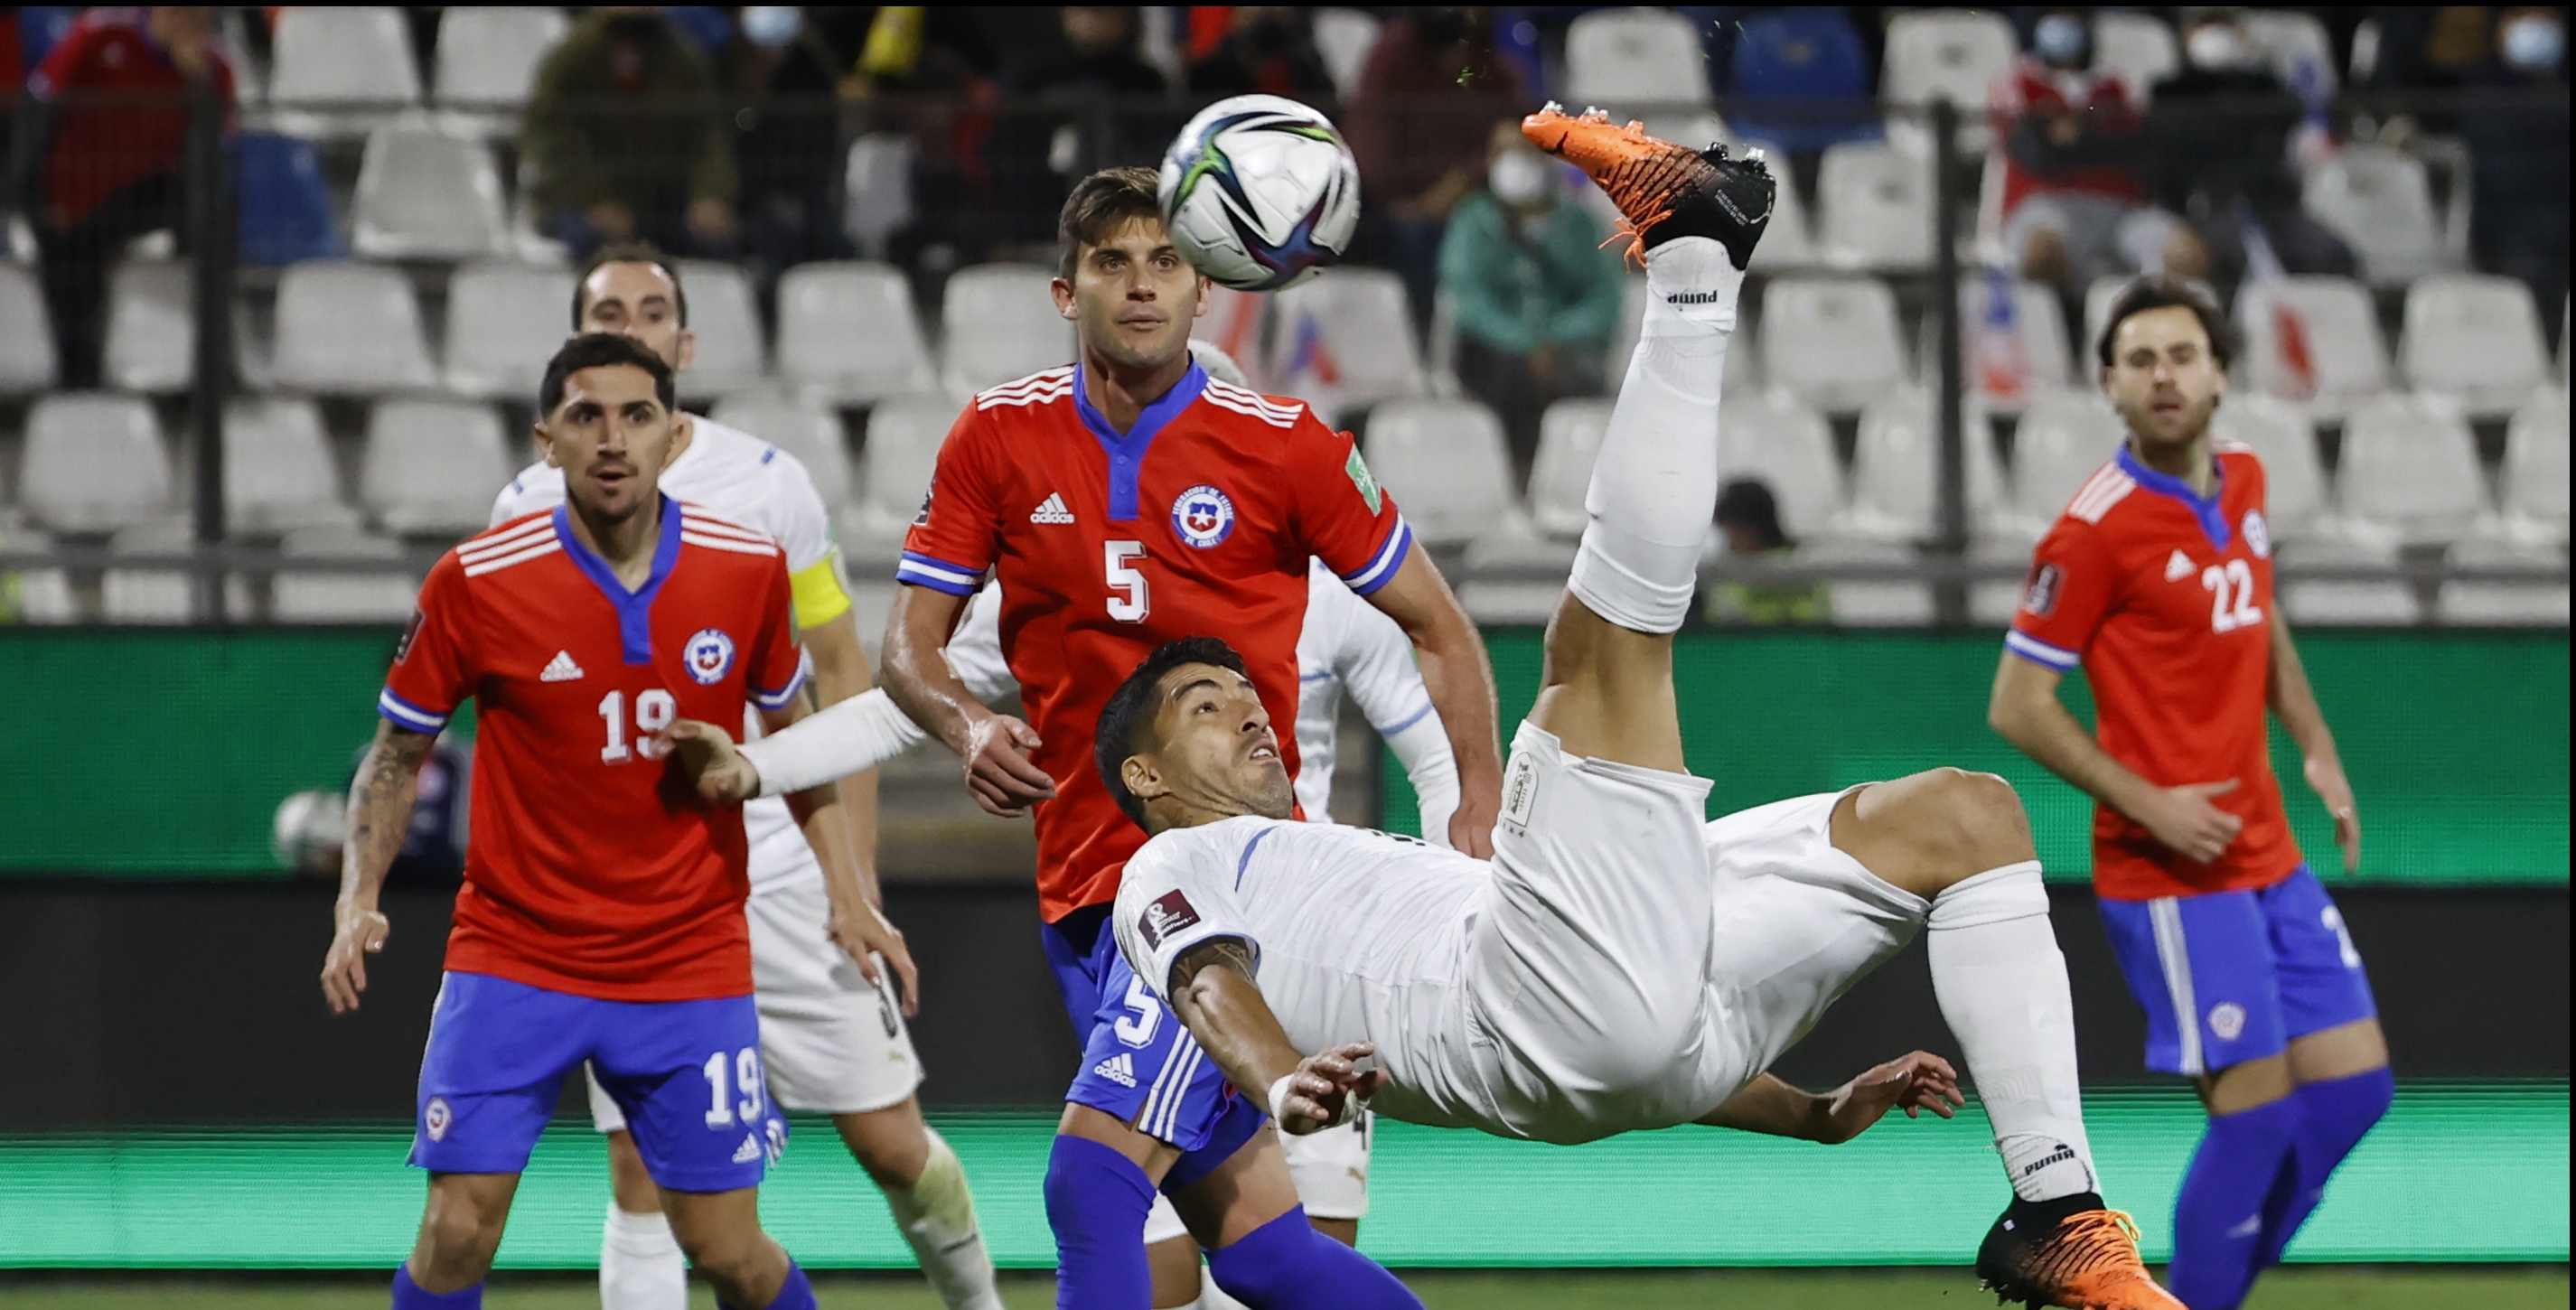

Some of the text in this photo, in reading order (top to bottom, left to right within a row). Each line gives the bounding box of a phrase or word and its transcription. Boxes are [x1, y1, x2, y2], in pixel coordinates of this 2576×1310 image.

[1029, 510, 1075, 524] adidas
[1104, 540, 1150, 623] 5
[2201, 558, 2263, 634] 22
[598, 688, 677, 766] 19
[1113, 973, 1163, 1050] 5
[704, 1047, 763, 1130] 19
[1093, 1064, 1138, 1089] adidas
